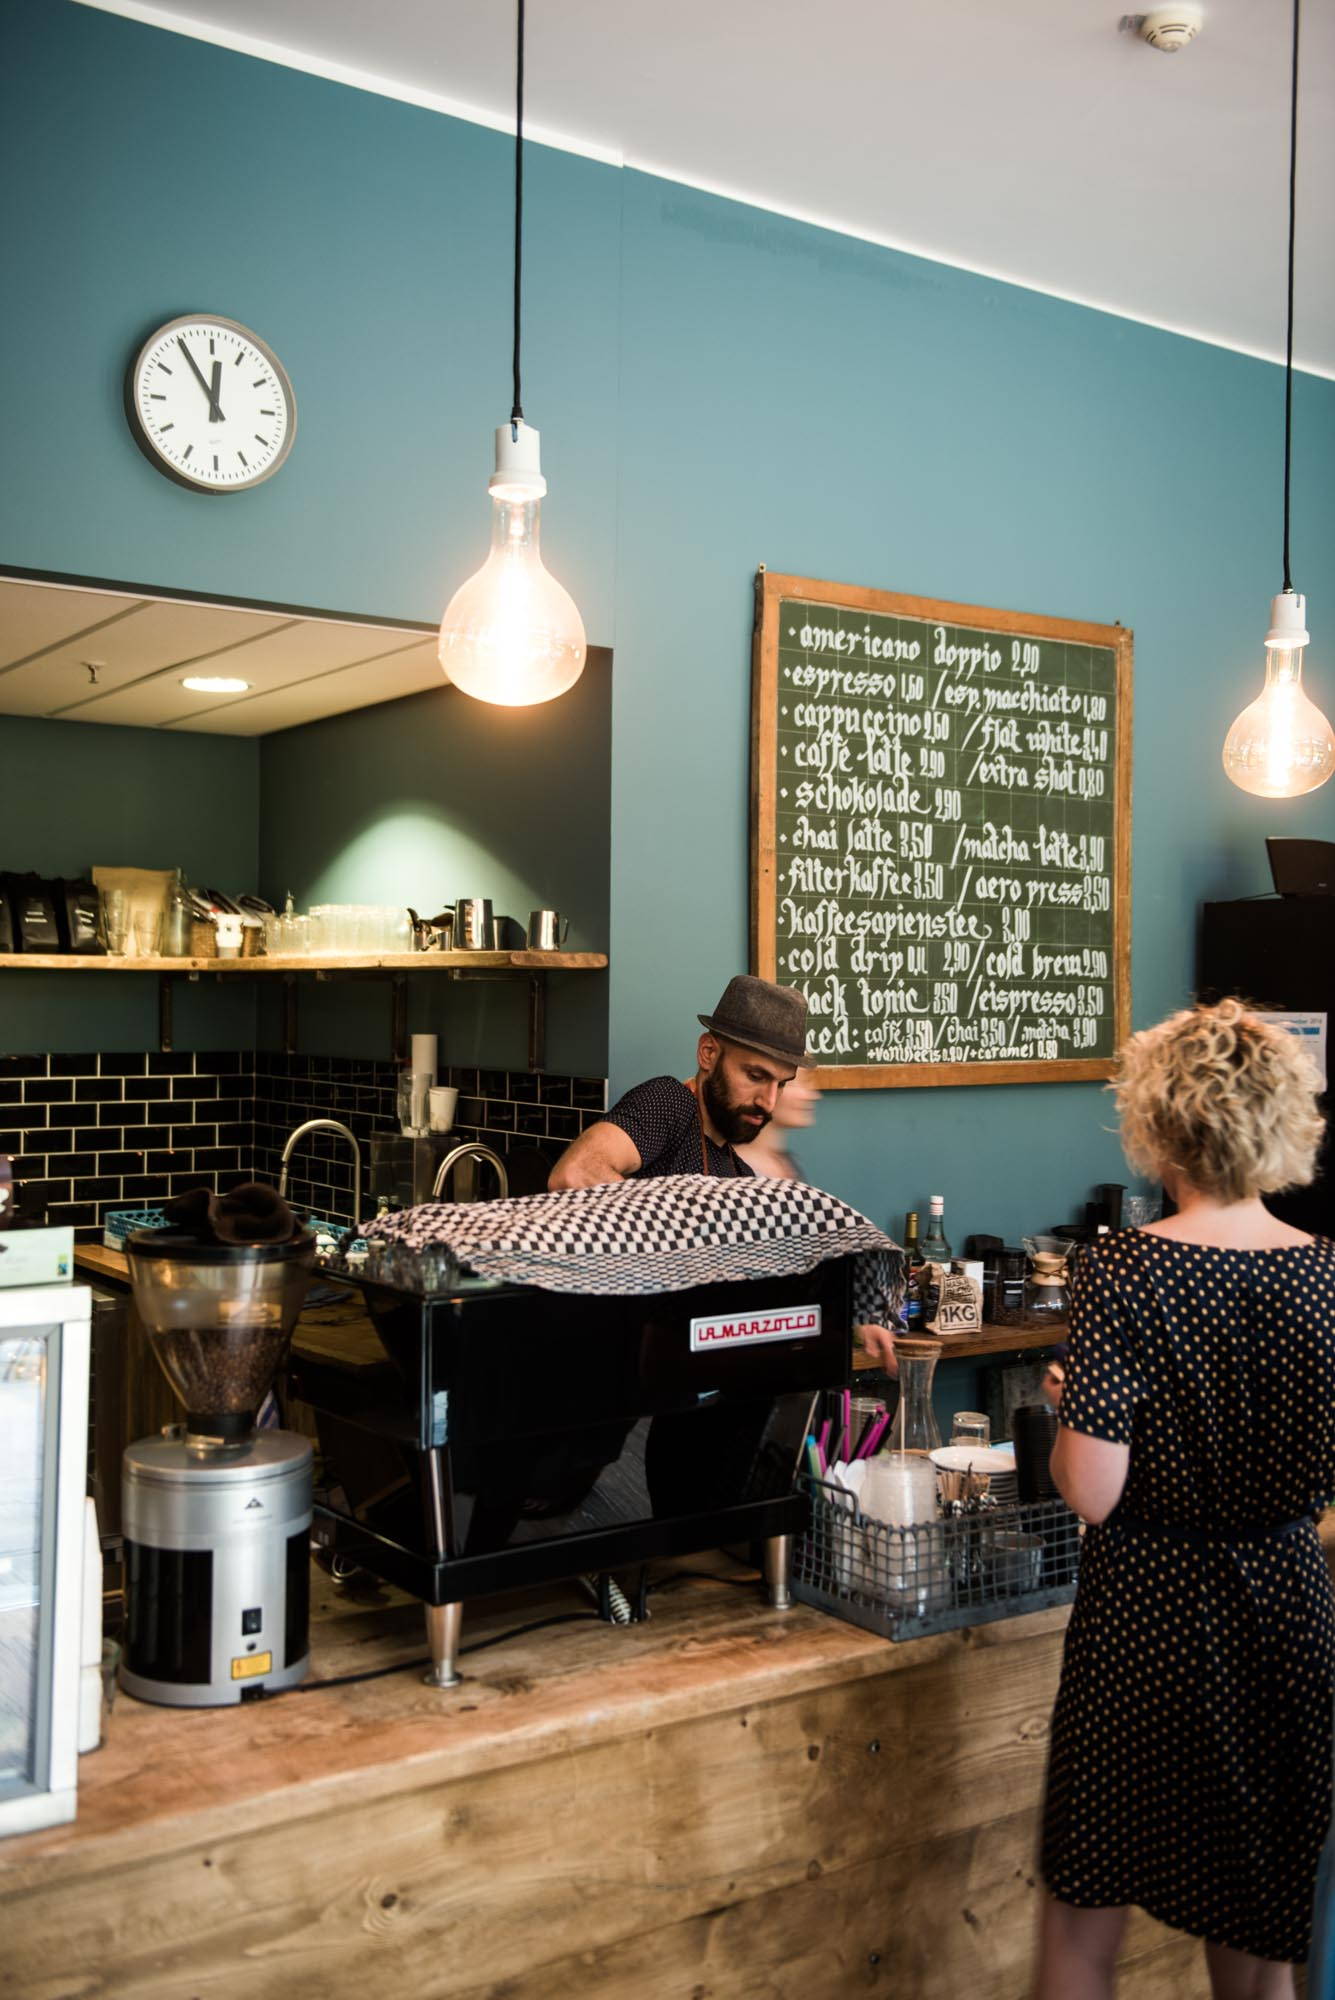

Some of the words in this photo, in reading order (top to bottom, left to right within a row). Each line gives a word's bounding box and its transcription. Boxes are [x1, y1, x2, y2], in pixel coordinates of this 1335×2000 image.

[800, 624, 921, 661] americano
[934, 627, 1002, 681] doppio
[1012, 640, 1040, 677] 2,20
[792, 665, 896, 699] espresso
[983, 681, 1081, 715] macchiato
[794, 703, 921, 741] cappuccino
[1026, 720, 1082, 756] white
[857, 727, 915, 777] latte
[1033, 755, 1077, 796] shot
[795, 772, 932, 818] schokolade
[793, 815, 839, 850] chai
[846, 818, 897, 856] latte
[788, 935, 840, 976] cold
[851, 928, 904, 986] drip
[790, 974, 848, 1024] lack
[857, 977, 930, 1019] tonic
